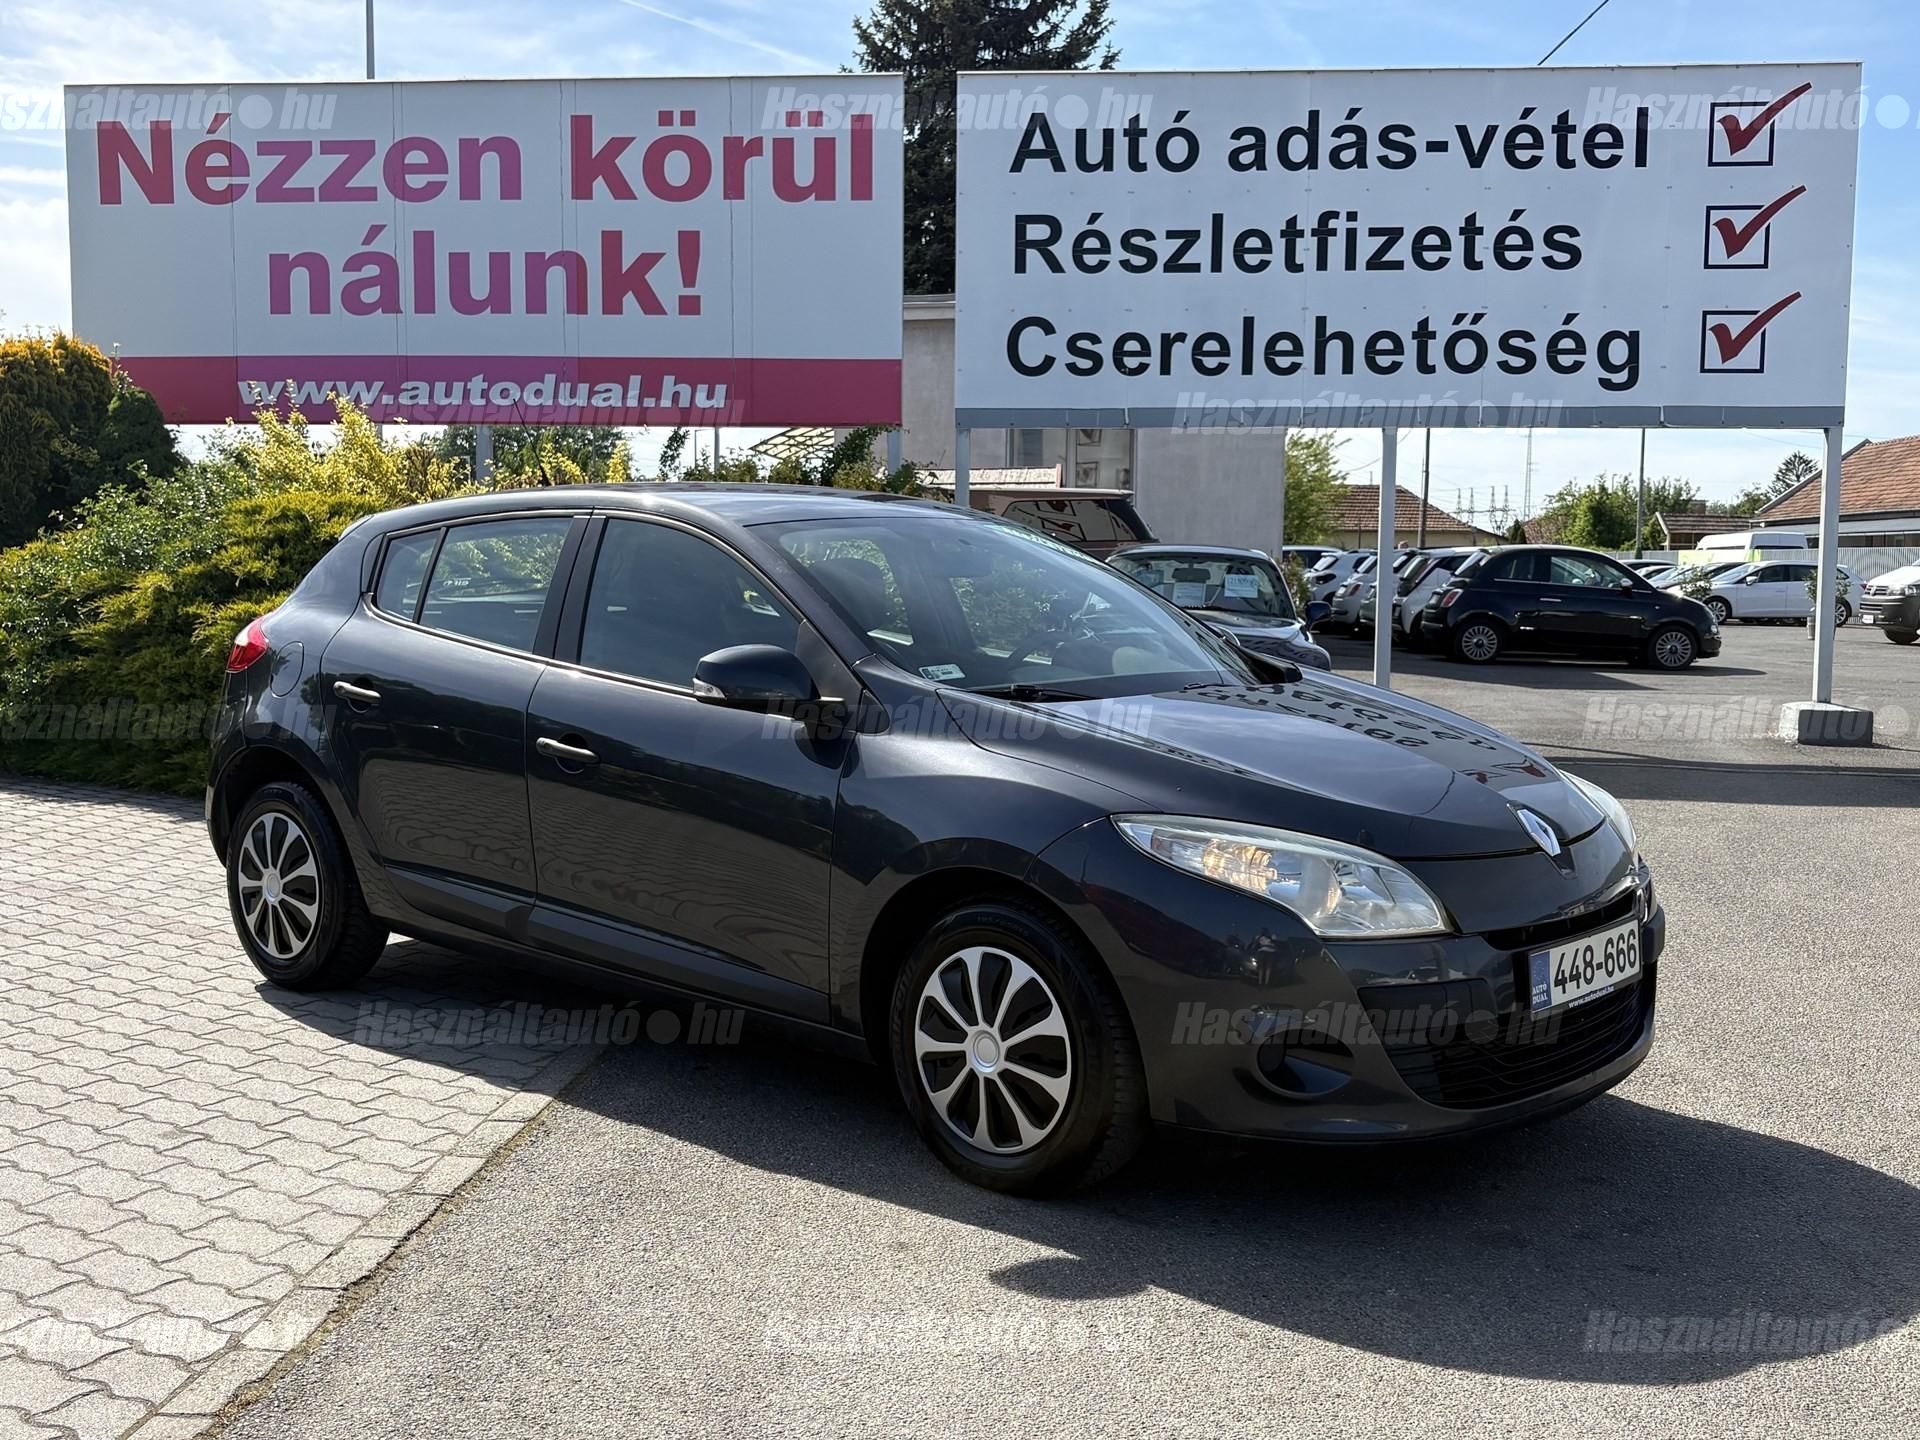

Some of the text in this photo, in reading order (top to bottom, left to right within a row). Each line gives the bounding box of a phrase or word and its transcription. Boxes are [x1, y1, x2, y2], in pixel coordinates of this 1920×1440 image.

[96, 110, 873, 205] Nézzen körül
[1008, 107, 1649, 173] Autó adás-vétel
[269, 224, 703, 316] nálunk!
[1014, 208, 1582, 275] Részletfizetés
[1006, 312, 1640, 392] Cserelehetőség
[238, 374, 727, 409] www.autodual.hu
[1553, 928, 1637, 994] 448-666
